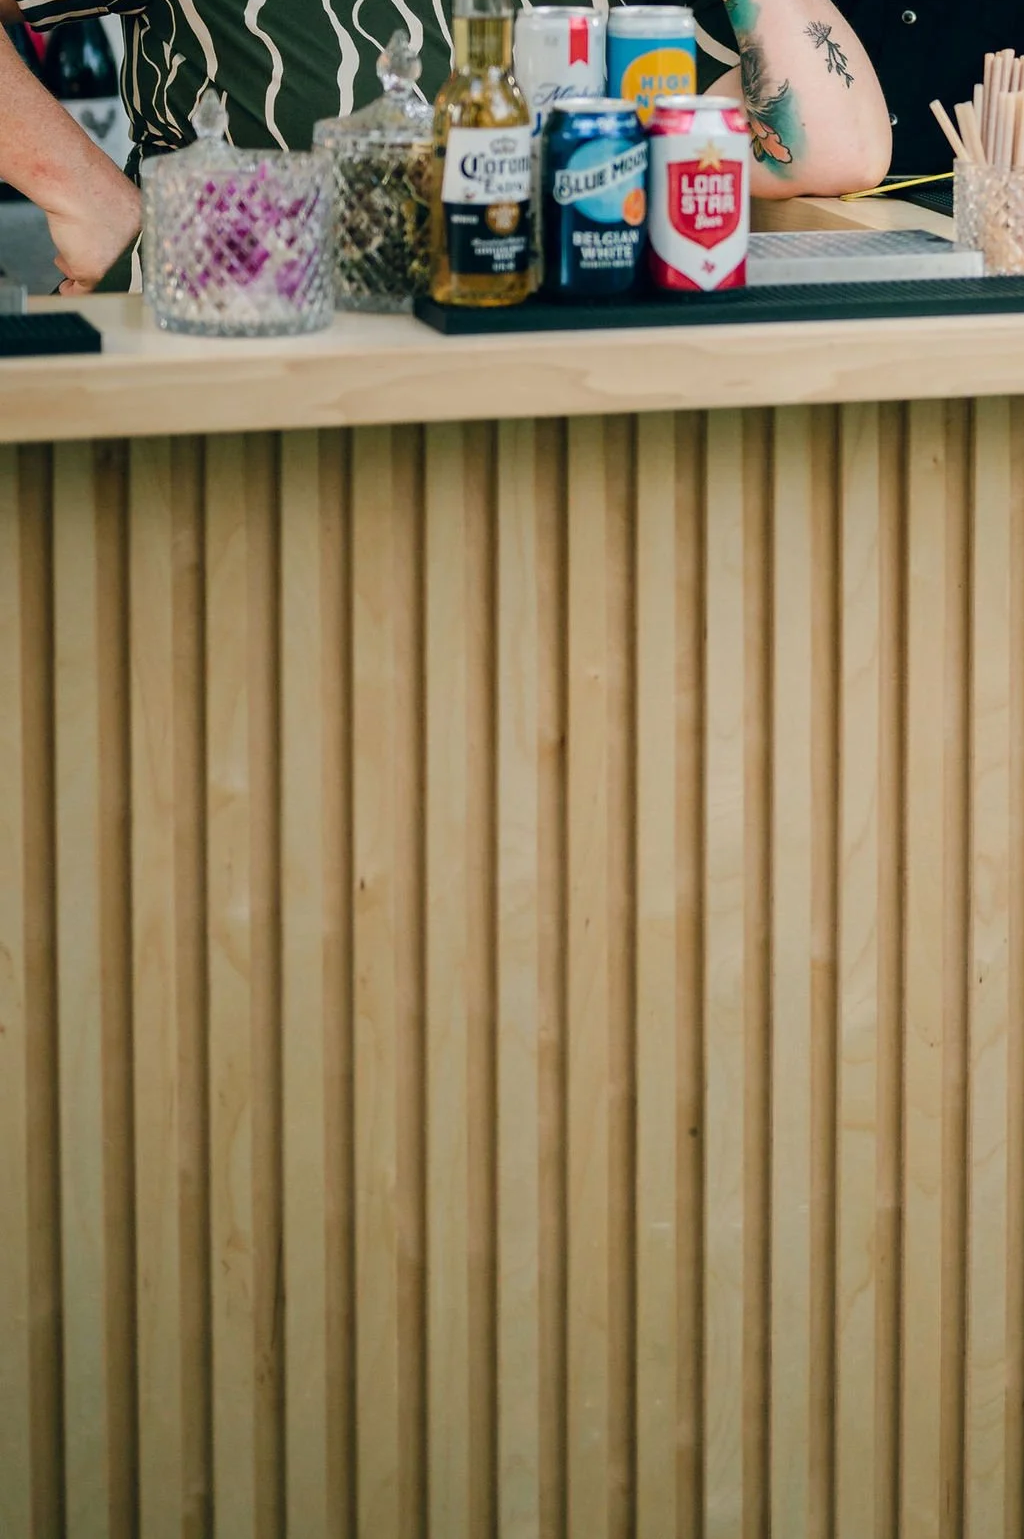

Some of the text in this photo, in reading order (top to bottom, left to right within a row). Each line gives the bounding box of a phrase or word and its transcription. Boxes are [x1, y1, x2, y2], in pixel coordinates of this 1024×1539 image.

[641, 74, 690, 91] HIGH
[461, 152, 531, 181] Coron
[559, 168, 606, 198] BLUE
[681, 173, 735, 194] LONE
[681, 194, 735, 215] STAR
[572, 229, 640, 247] BELGIAN
[580, 245, 633, 260] WHITE
